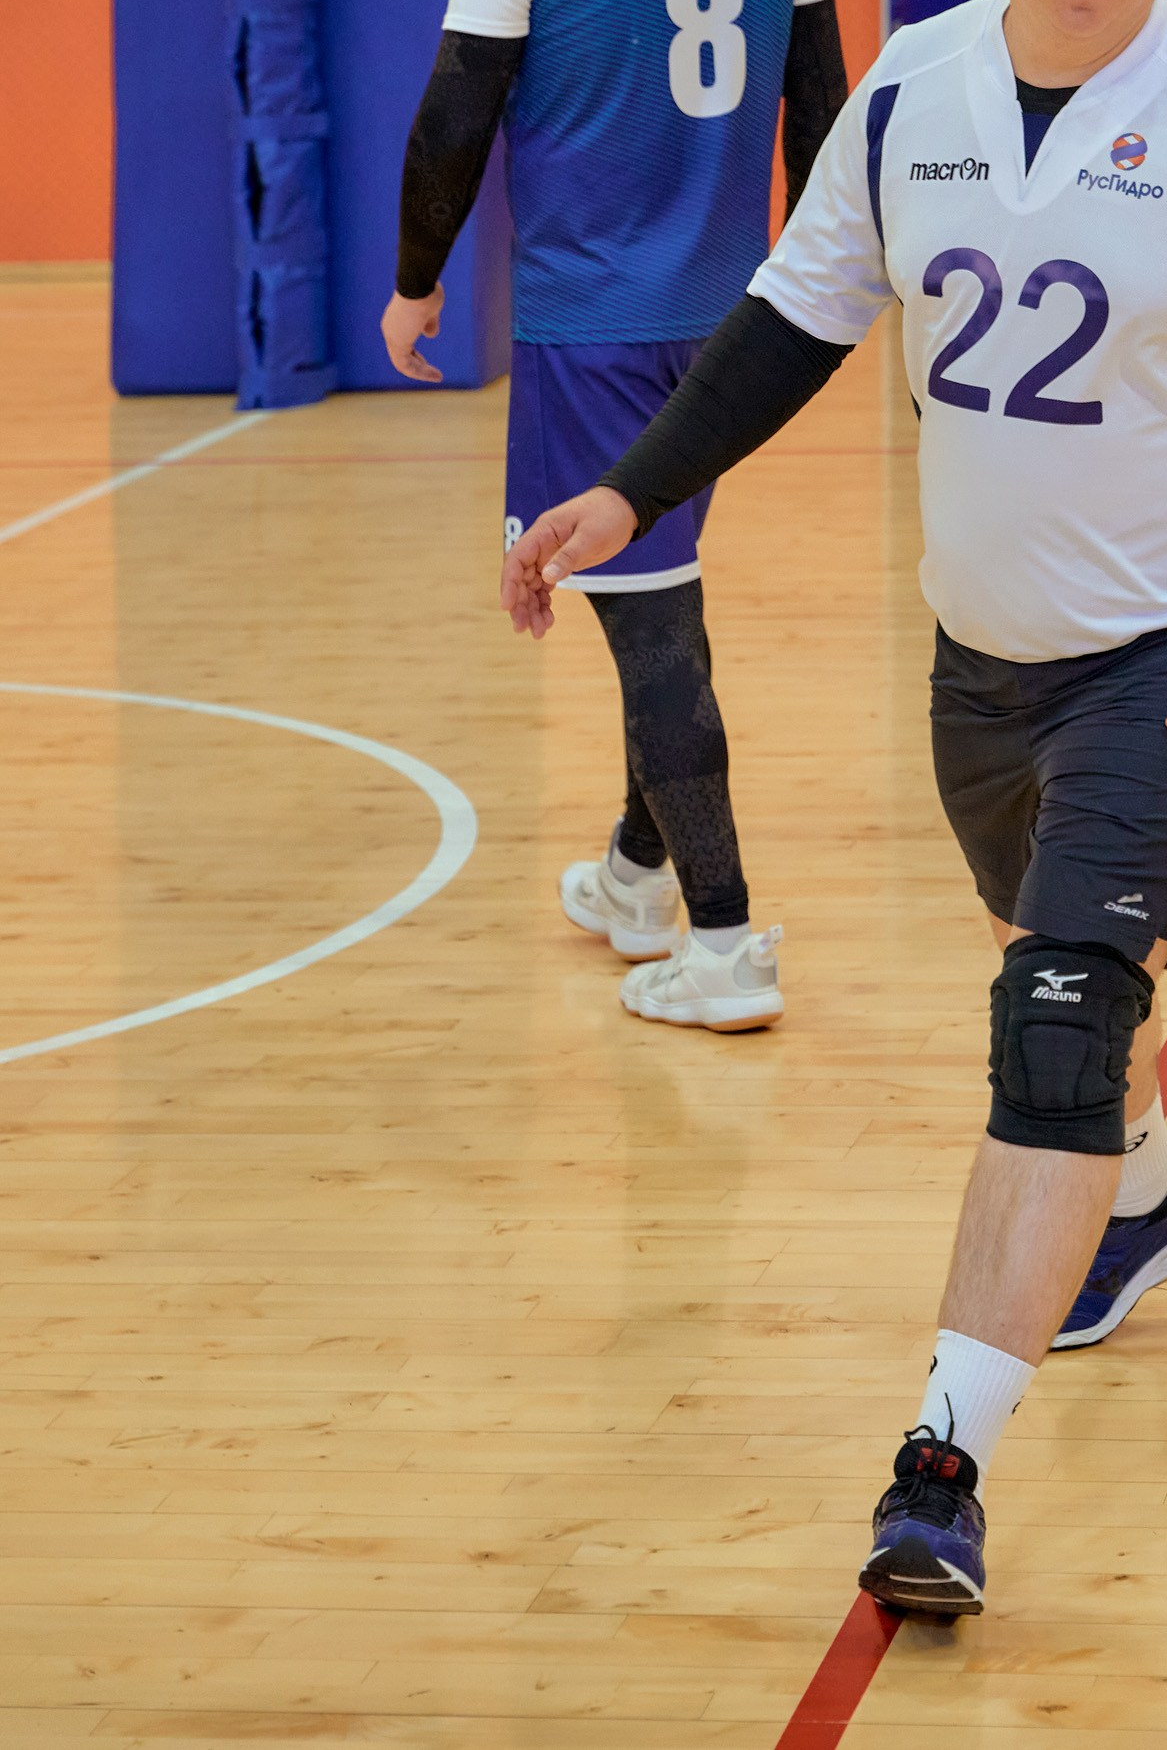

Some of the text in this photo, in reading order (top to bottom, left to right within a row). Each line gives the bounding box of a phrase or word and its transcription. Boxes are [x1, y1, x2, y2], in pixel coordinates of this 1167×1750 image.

[909, 157, 989, 181] macron
[1077, 168, 1164, 200] РусГидро
[922, 247, 1110, 426] 22
